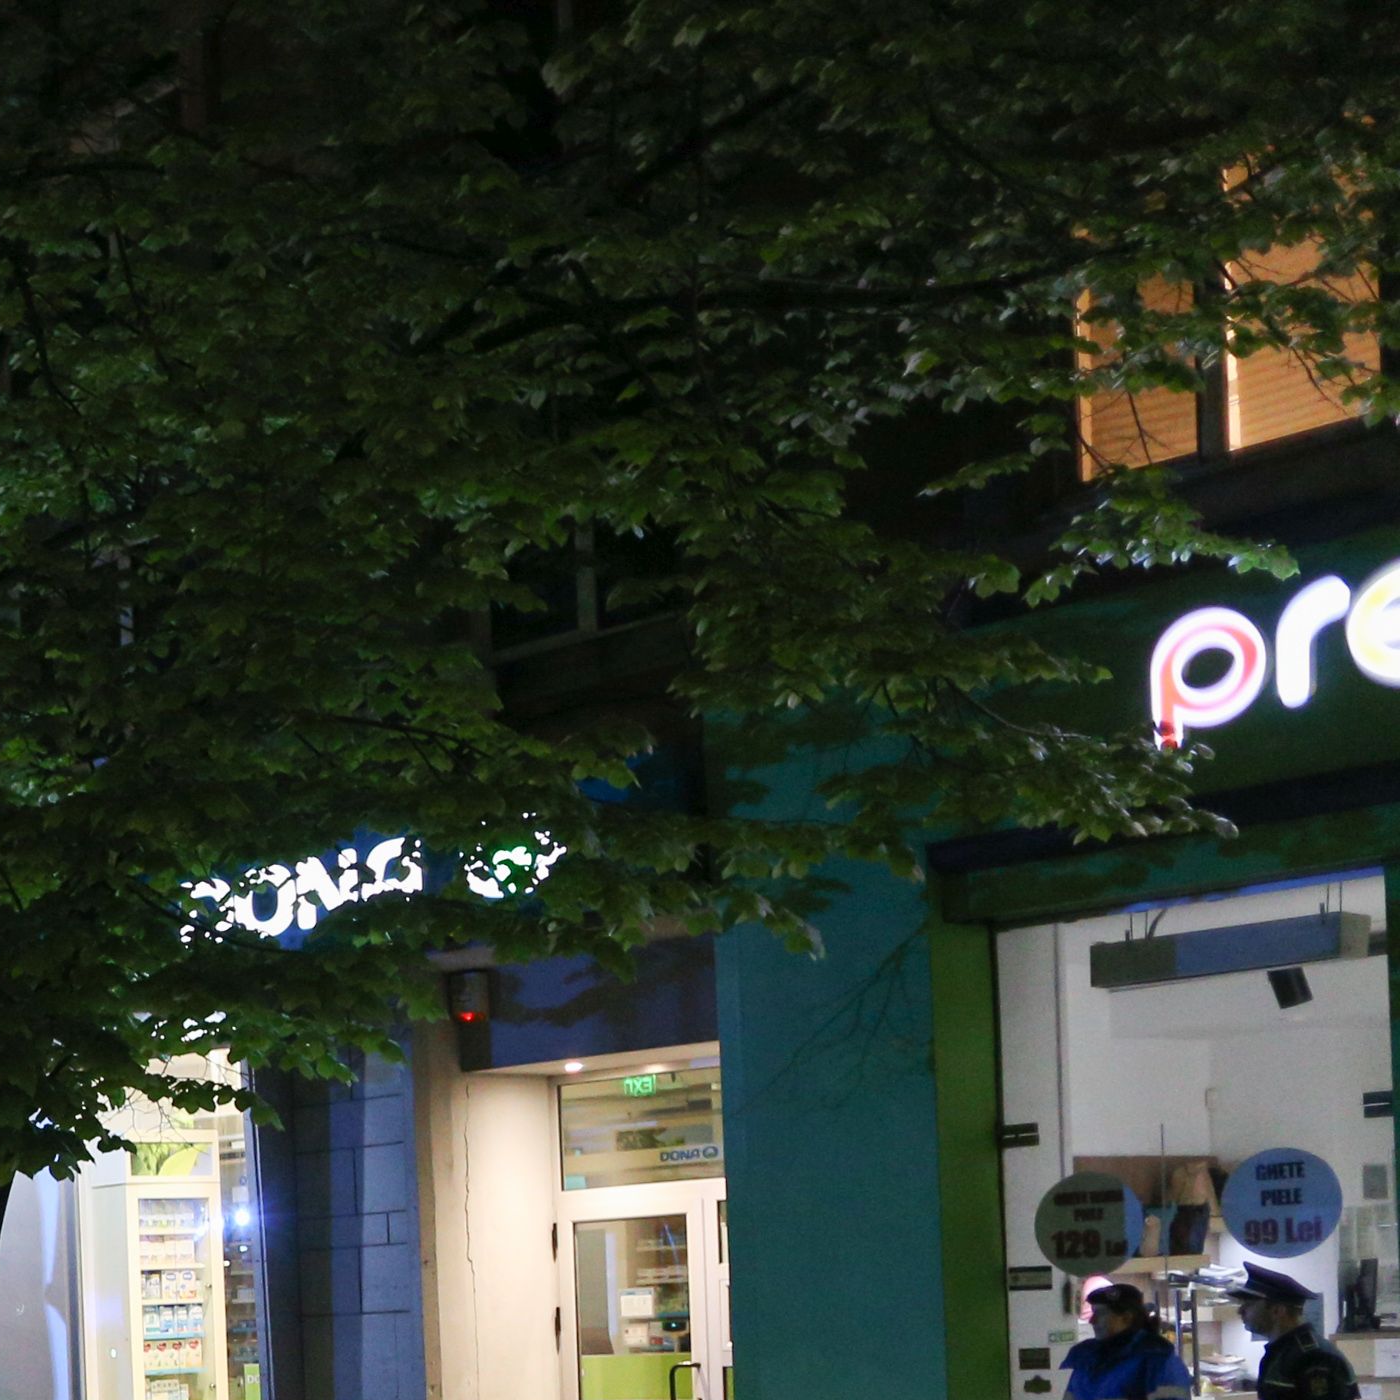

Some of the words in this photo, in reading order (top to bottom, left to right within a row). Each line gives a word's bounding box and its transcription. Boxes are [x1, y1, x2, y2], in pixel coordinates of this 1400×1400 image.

[1261, 1187, 1304, 1207] PIELE
[1244, 1218, 1279, 1246] 99
[1285, 1216, 1323, 1244] Lei
